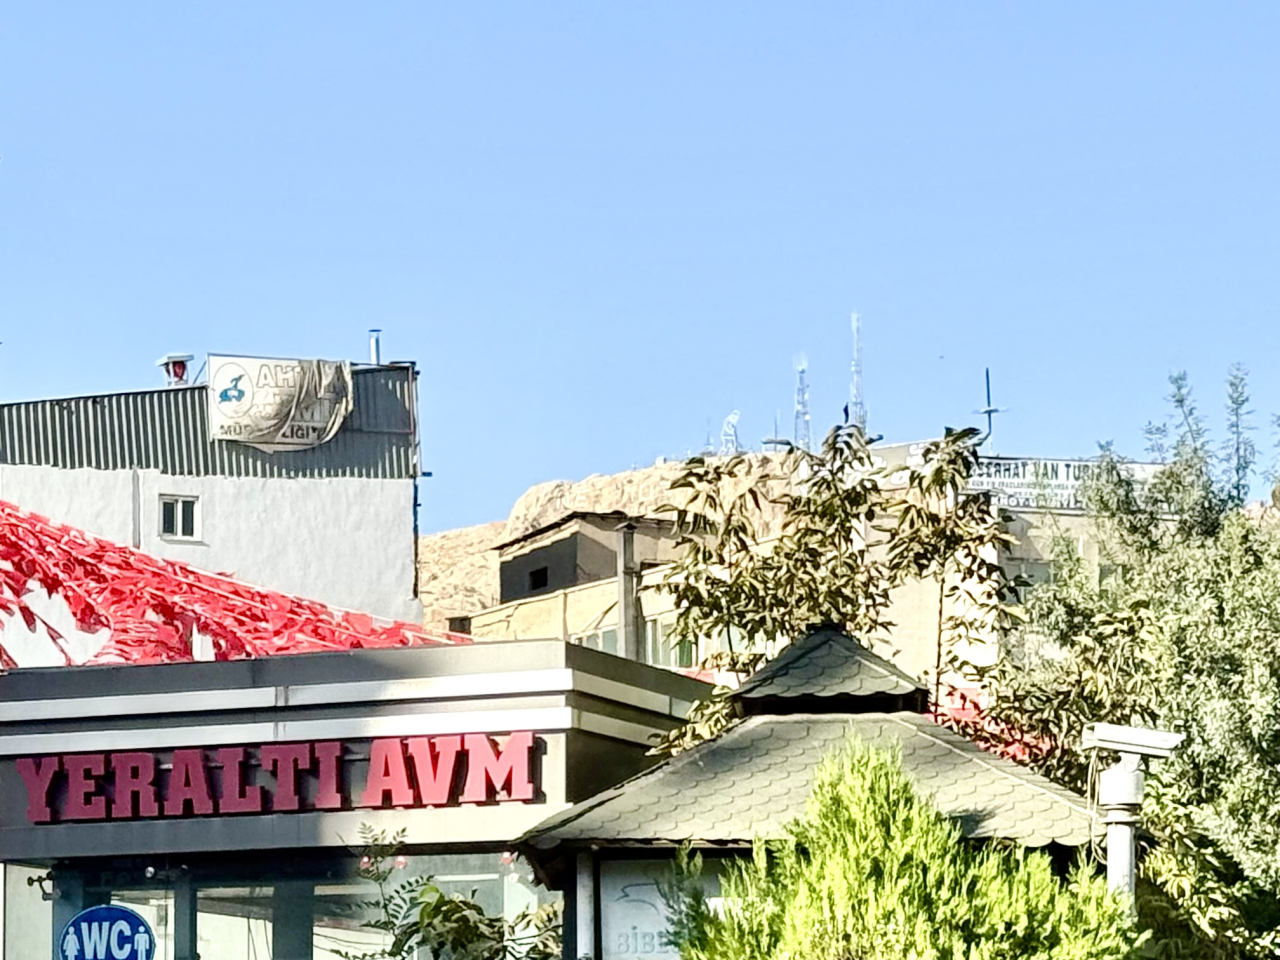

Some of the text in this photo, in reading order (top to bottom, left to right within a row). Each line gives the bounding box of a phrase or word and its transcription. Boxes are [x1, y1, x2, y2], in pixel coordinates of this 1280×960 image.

[16, 732, 536, 824] YERALTI AVM
[81, 920, 132, 960] WC
